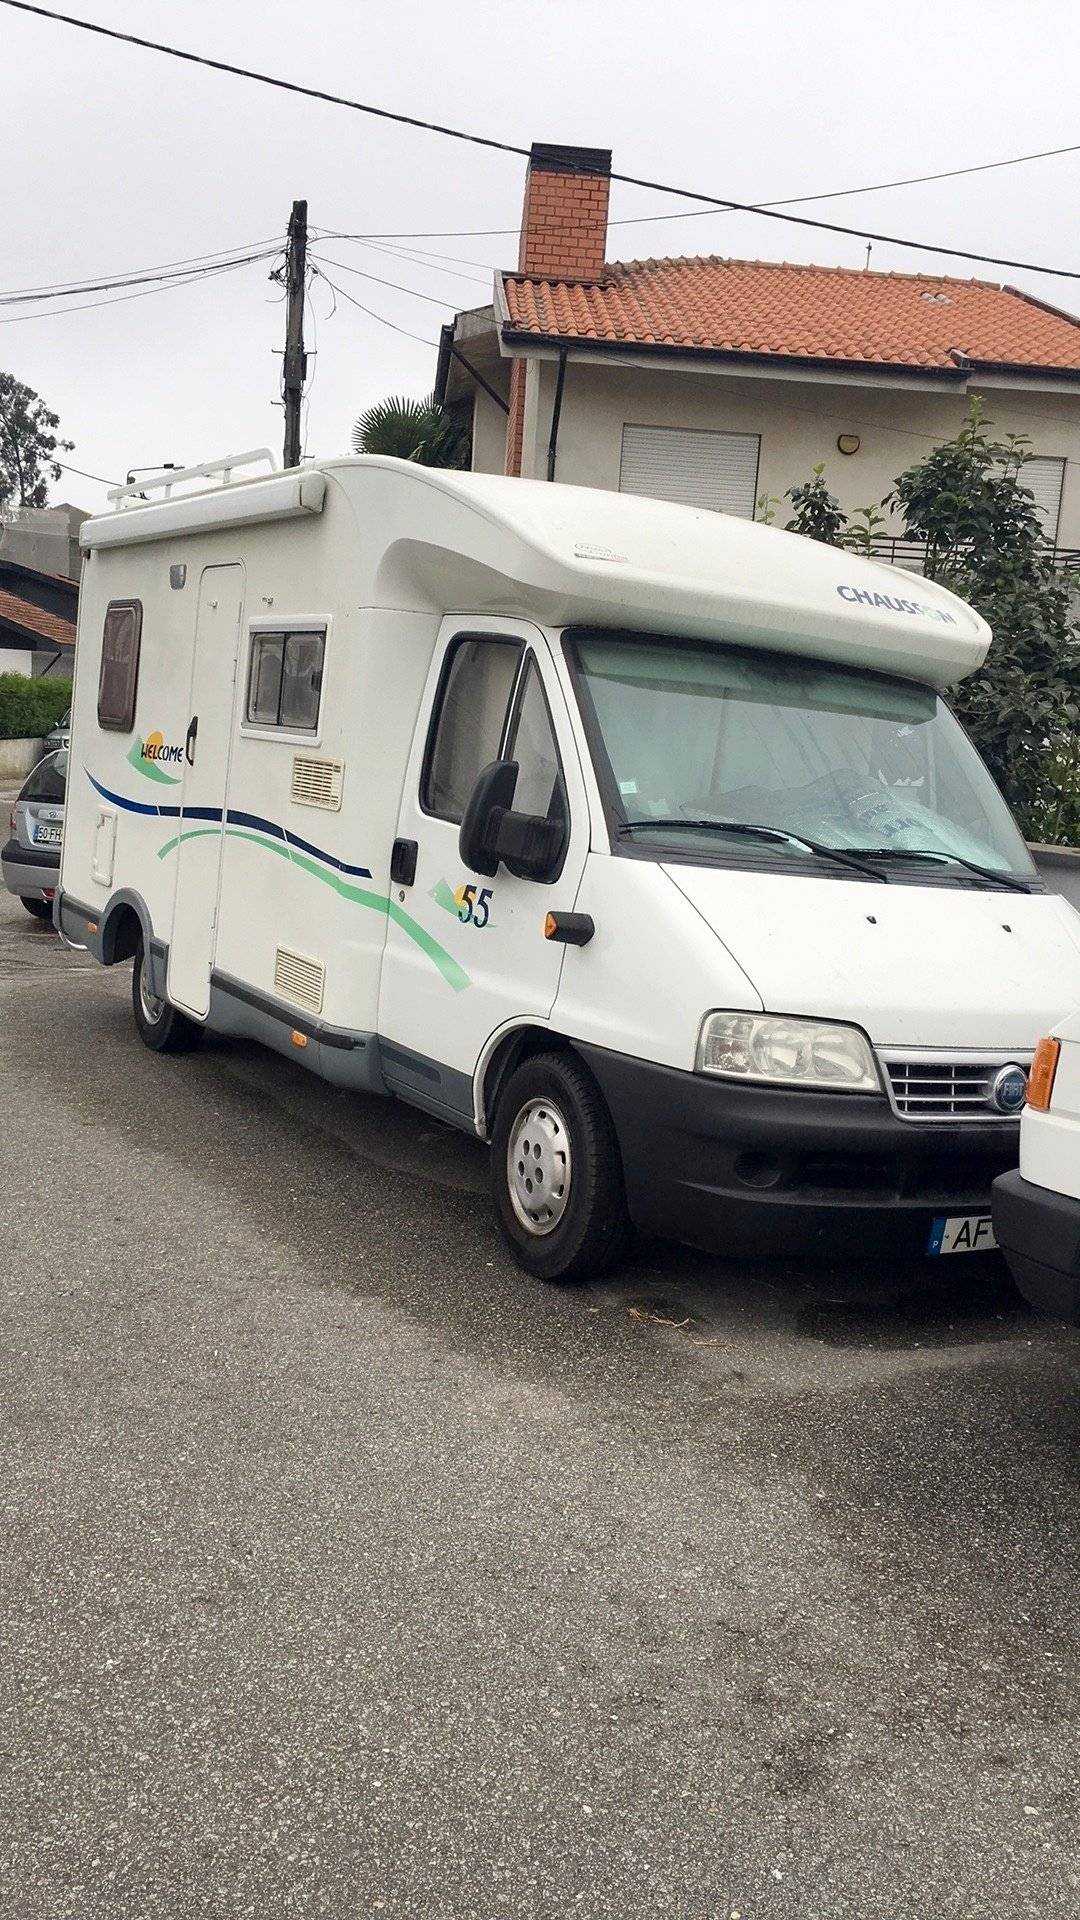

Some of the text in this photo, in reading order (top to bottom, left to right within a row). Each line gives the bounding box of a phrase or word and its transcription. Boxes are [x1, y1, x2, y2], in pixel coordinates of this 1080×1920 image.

[140, 743, 184, 763] WELCOME
[458, 884, 494, 928] 55
[1003, 1082, 1025, 1096] FIAT
